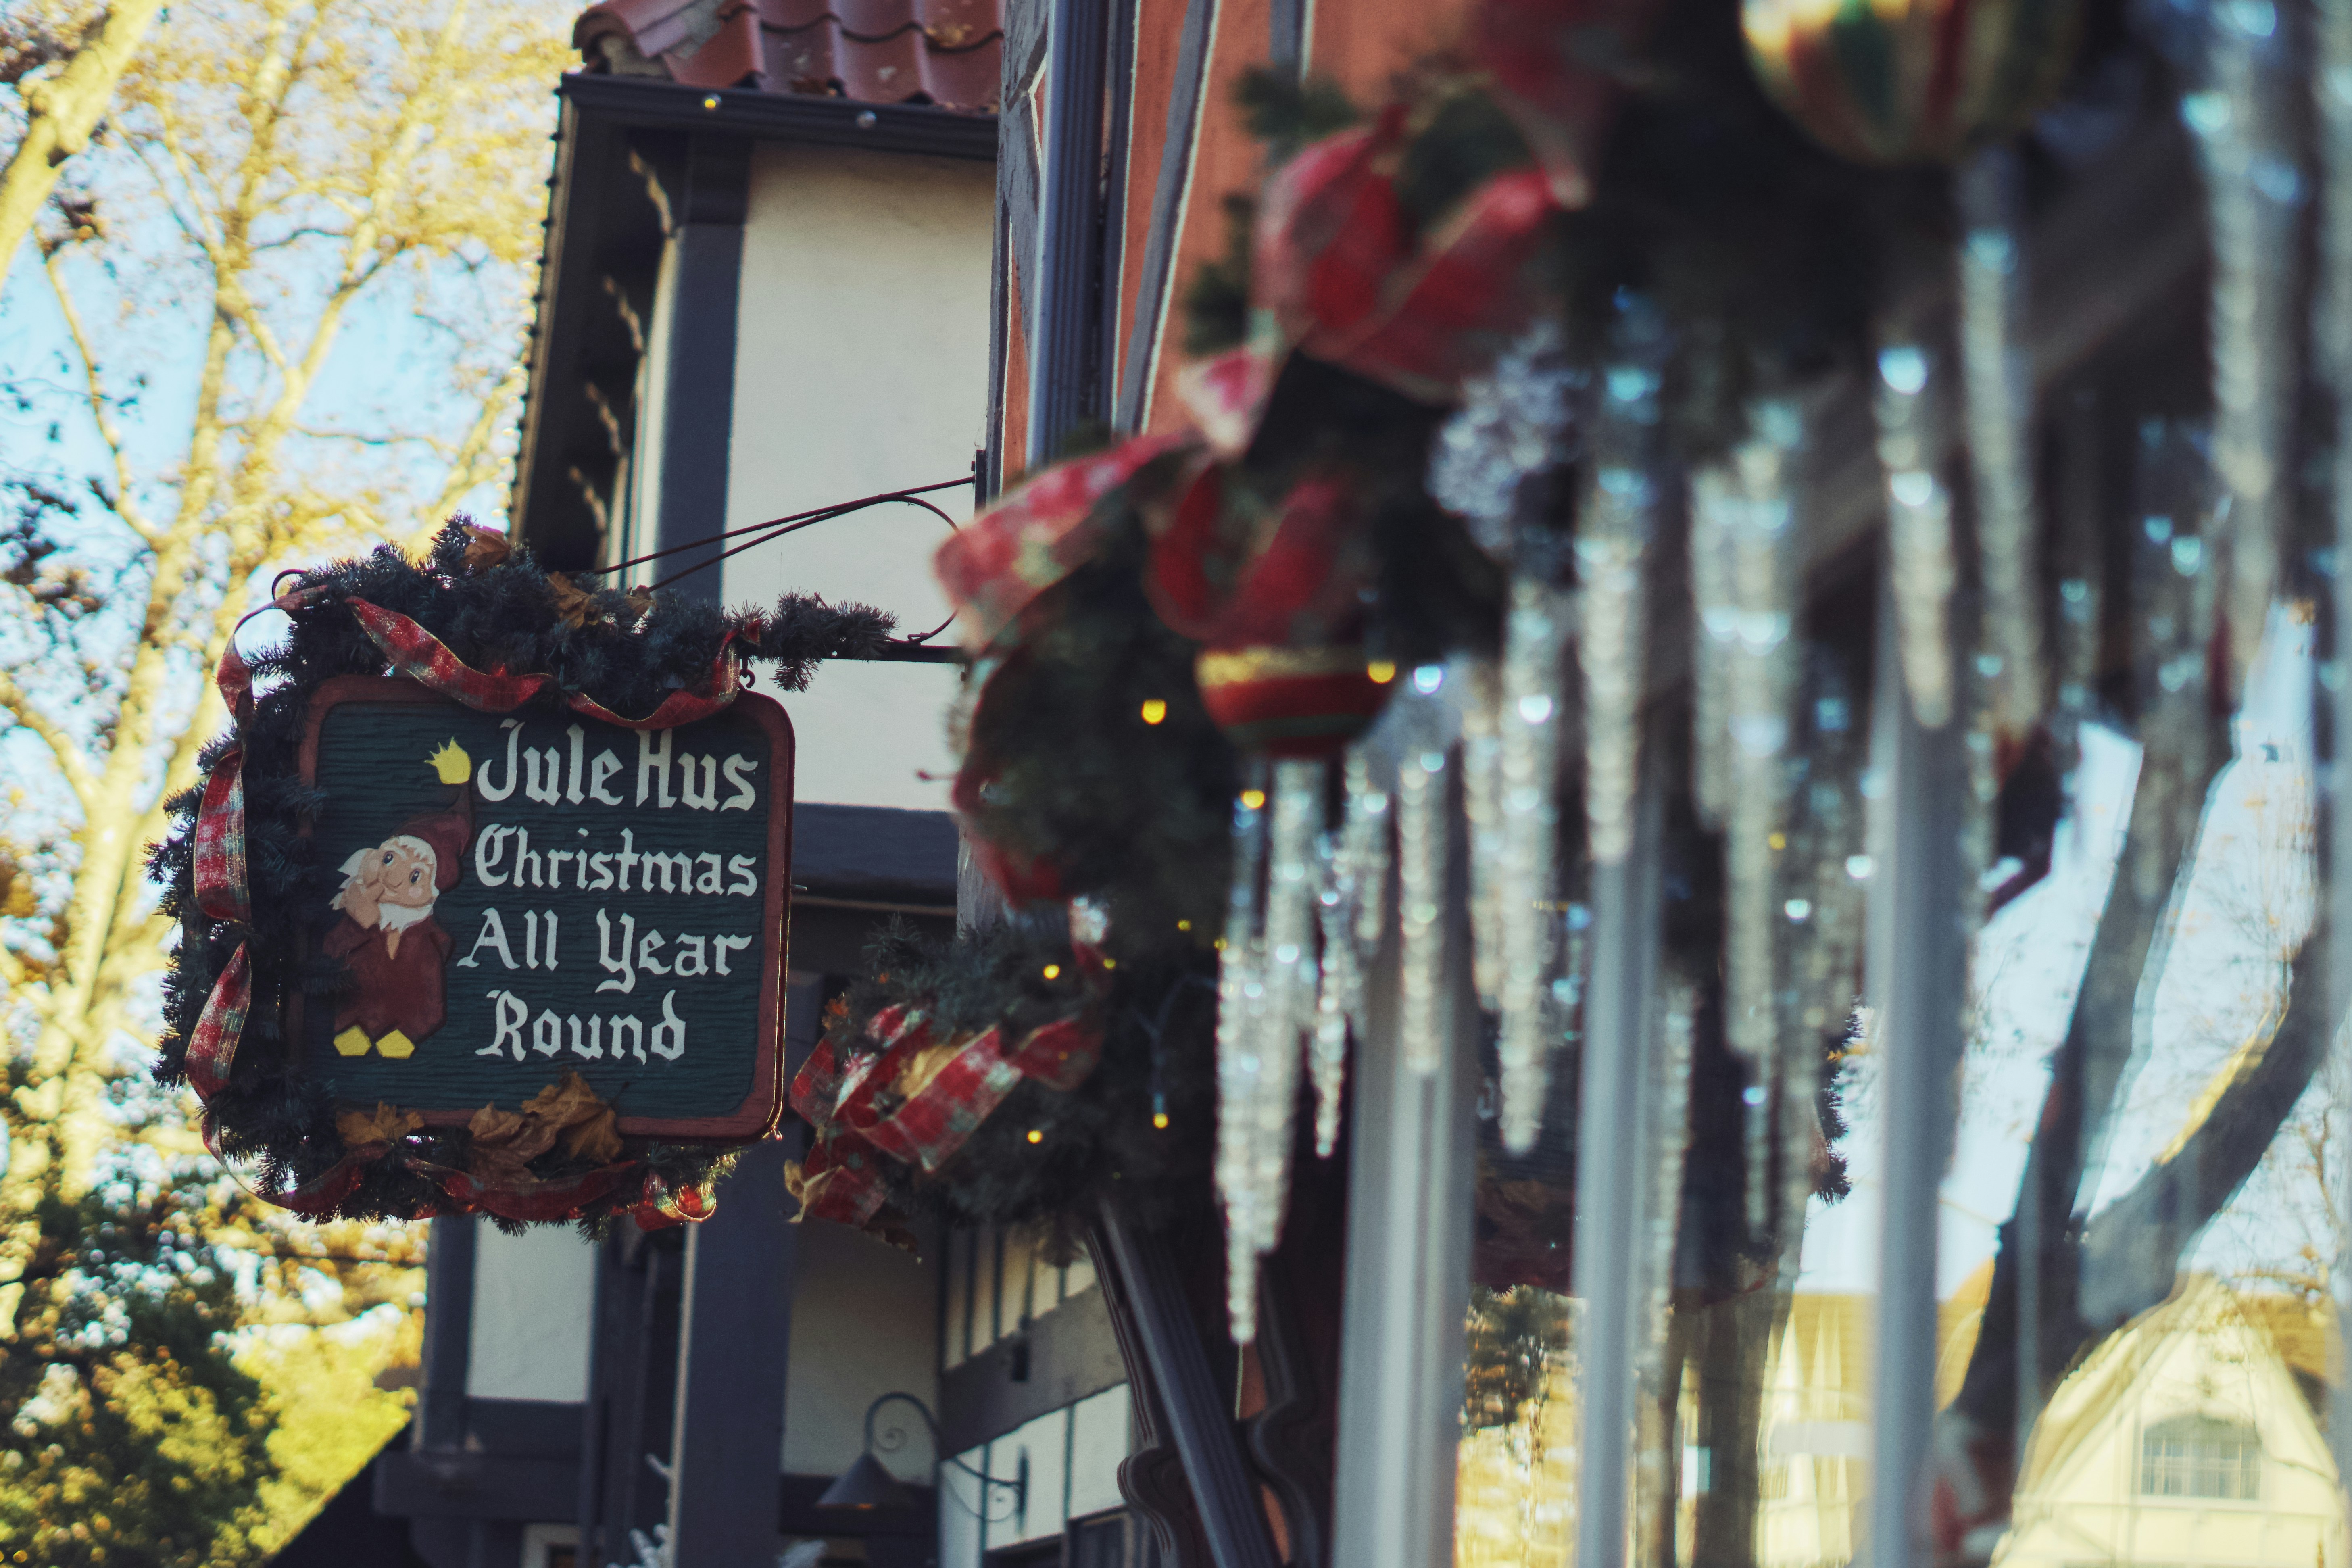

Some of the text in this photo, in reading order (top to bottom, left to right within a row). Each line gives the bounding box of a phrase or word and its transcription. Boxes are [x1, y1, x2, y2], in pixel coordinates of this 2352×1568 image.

[475, 823, 757, 897] Christmas
[457, 907, 752, 994] All Year
[475, 989, 686, 1066] Round
